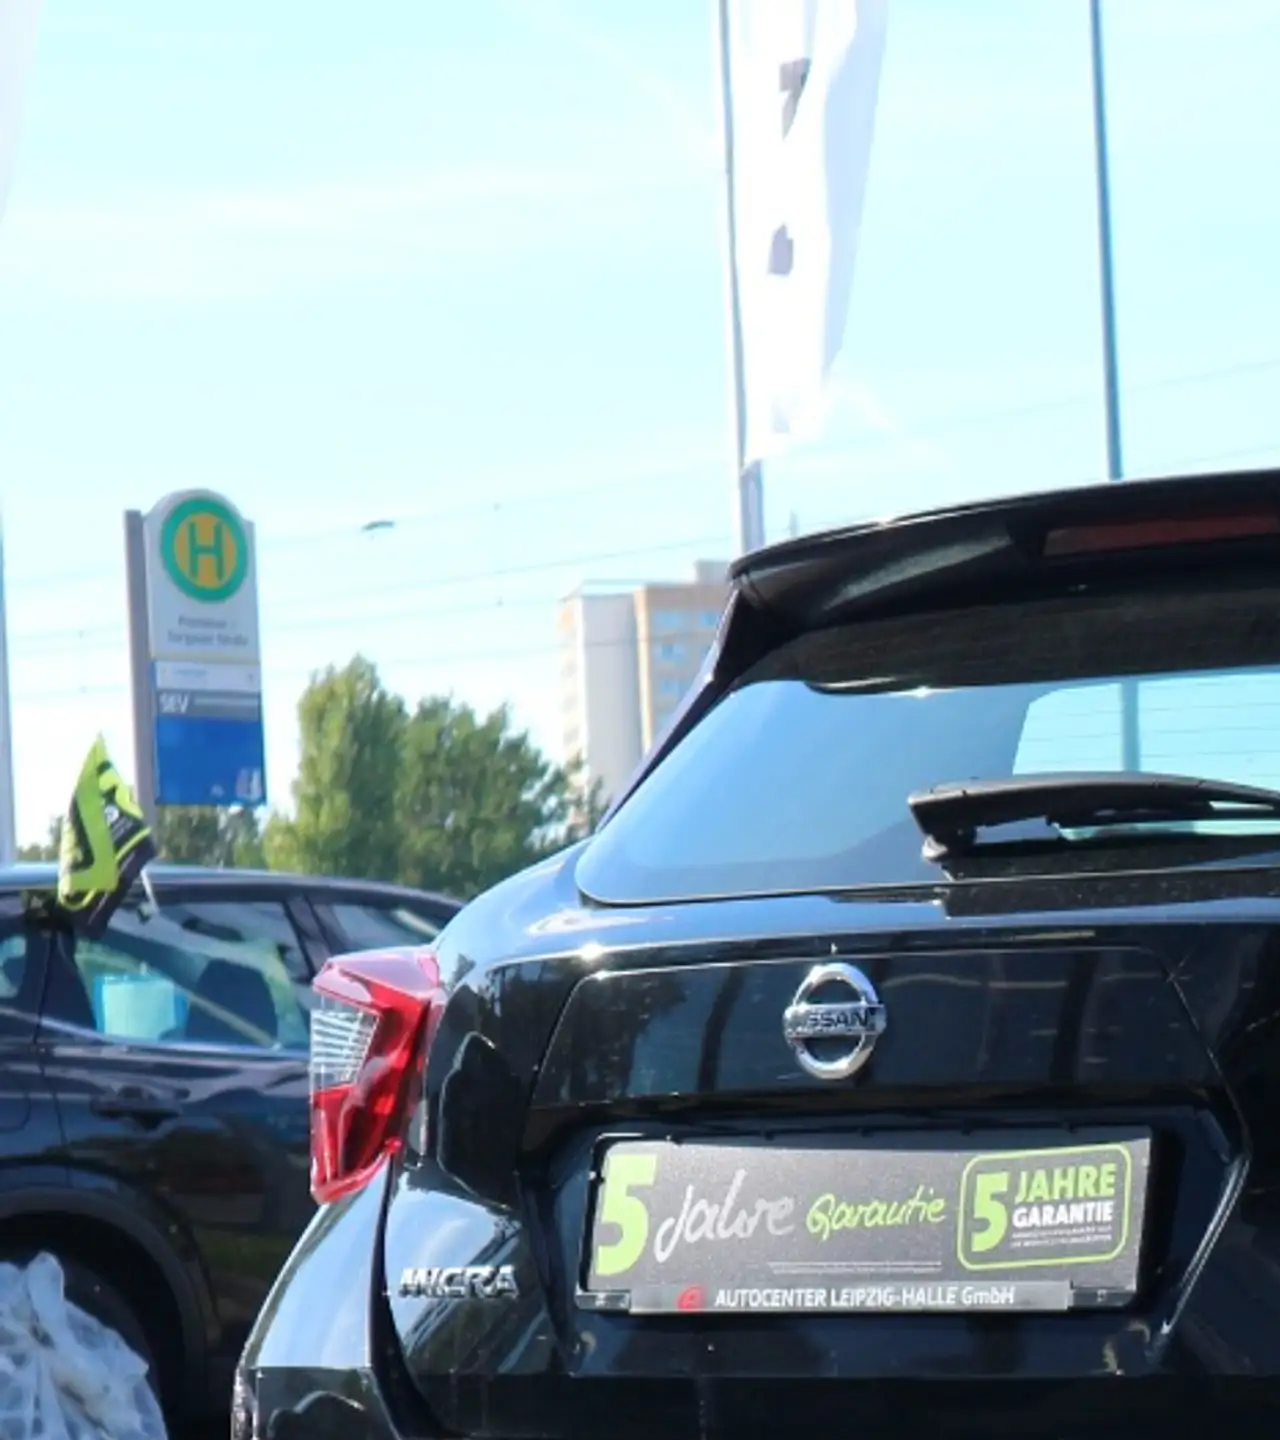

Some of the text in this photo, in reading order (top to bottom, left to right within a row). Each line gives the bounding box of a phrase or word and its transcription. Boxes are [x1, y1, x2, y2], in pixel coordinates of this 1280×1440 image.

[187, 520, 226, 582] H
[595, 1154, 658, 1276] 5
[653, 1168, 795, 1264] Jahre
[971, 1163, 1117, 1252] 5 JAHRE
[1011, 1200, 1115, 1229] GARANTIE
[399, 1264, 519, 1300] MICRA
[714, 1287, 828, 1308] AUTOCENTER
[830, 1285, 957, 1307] LEIPZIG-HALLE
[961, 1285, 1016, 1307] GmbH
